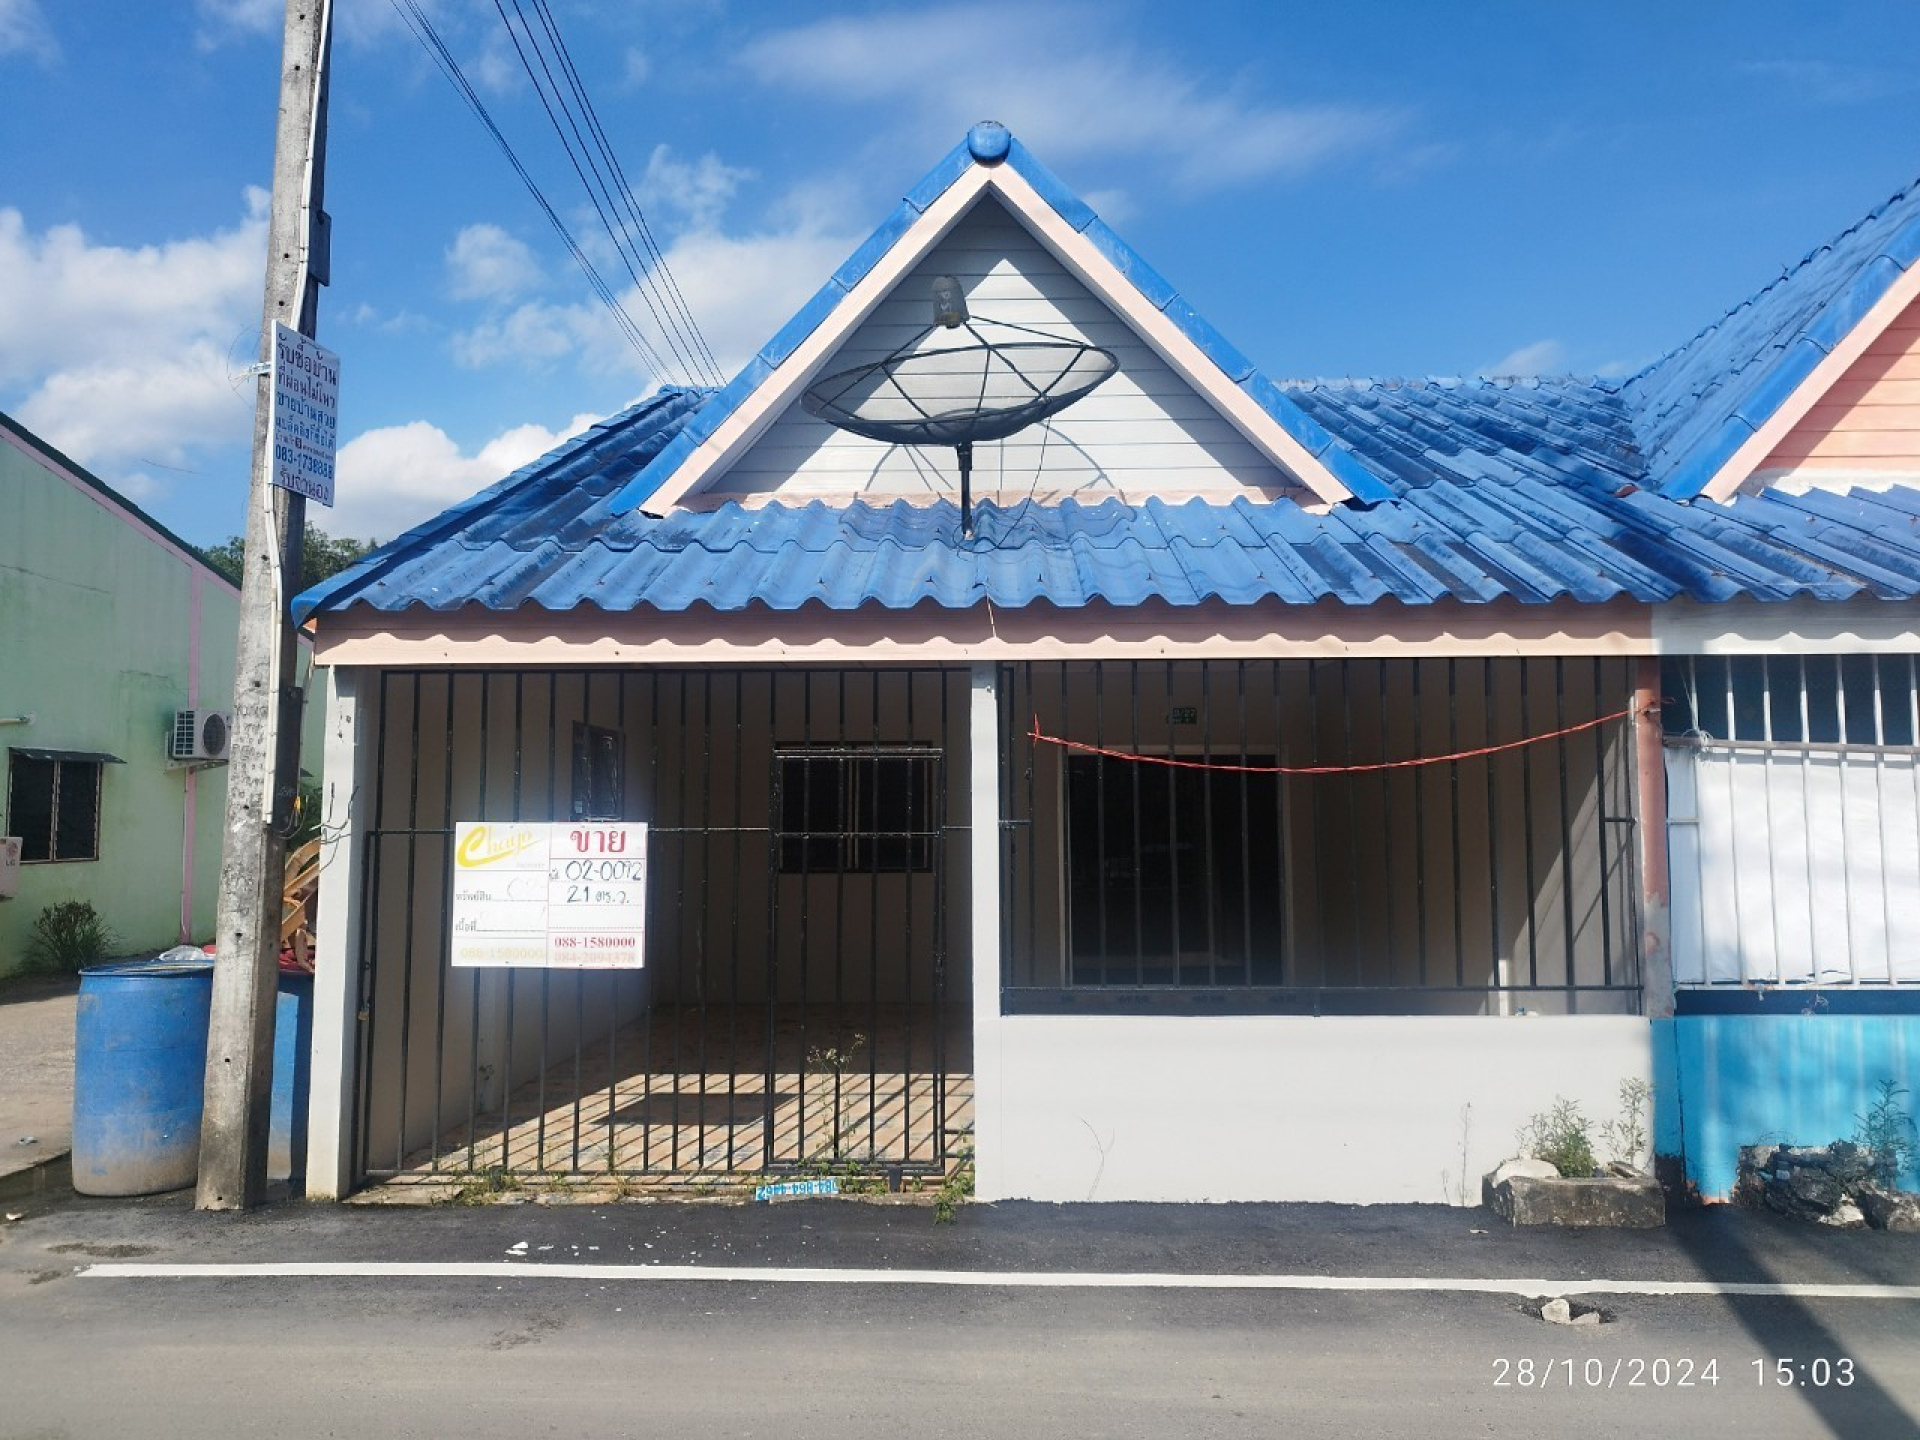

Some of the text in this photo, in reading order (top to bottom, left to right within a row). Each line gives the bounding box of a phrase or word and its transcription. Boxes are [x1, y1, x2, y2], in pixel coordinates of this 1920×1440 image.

[570, 830, 626, 853] ขาย
[567, 885, 589, 903] 21
[554, 936, 636, 948] 088-1580000
